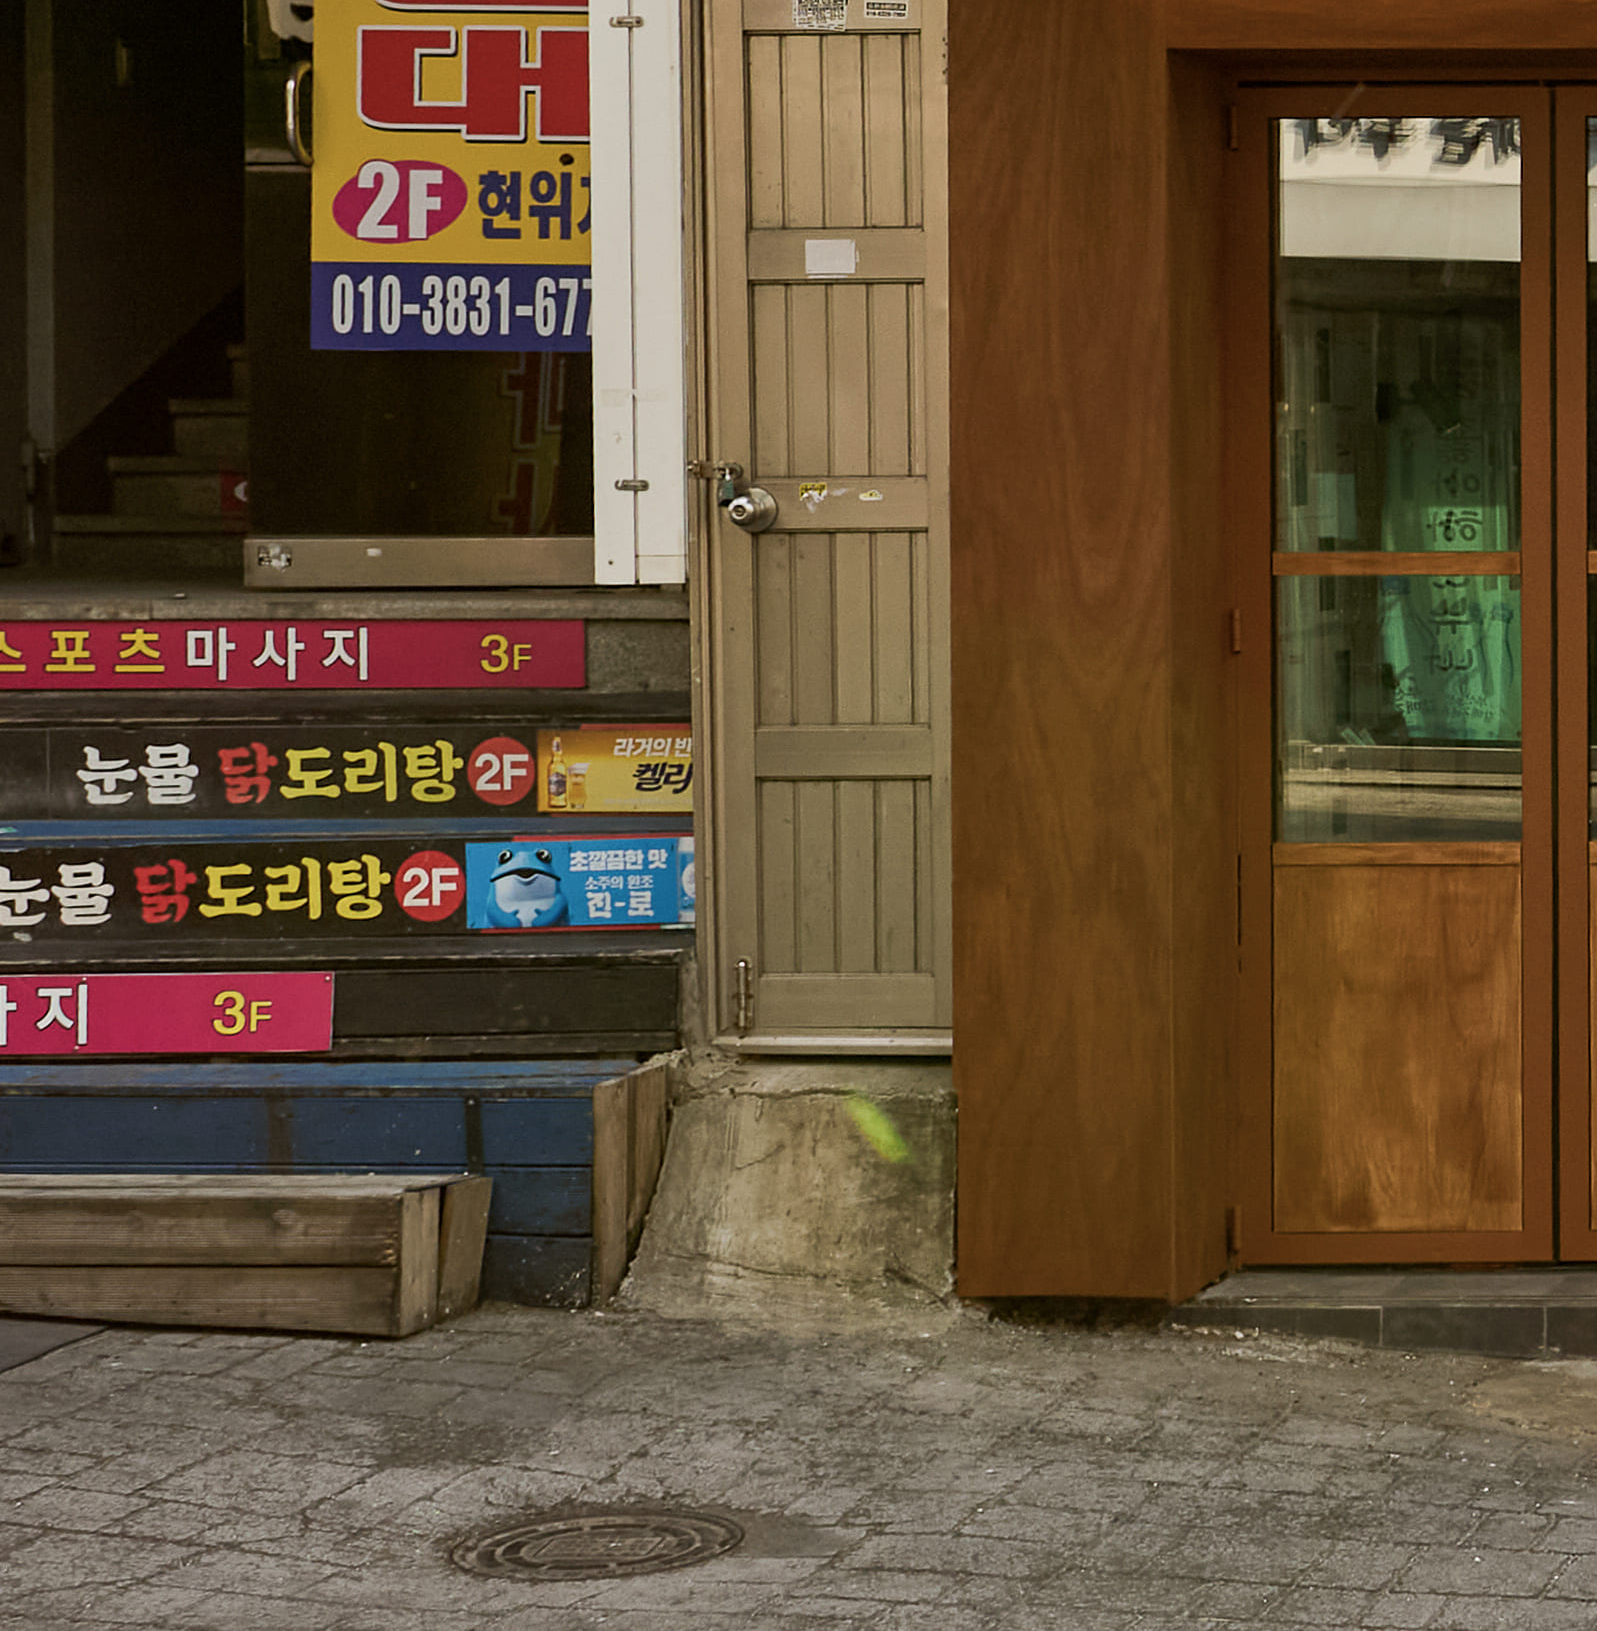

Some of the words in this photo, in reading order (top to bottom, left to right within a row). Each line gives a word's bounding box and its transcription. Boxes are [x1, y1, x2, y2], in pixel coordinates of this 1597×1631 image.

[356, 160, 444, 240] 2F
[185, 625, 370, 681] 마사지
[479, 633, 533, 674] 3F
[75, 741, 200, 806] 눈물
[216, 738, 466, 806] 닭도리탕
[474, 752, 529, 792] 2F
[612, 737, 671, 758] 라거의
[584, 875, 624, 891] 소주의
[627, 874, 654, 890] 원조
[647, 848, 669, 870] 맛
[0, 860, 115, 926] 눈물
[132, 854, 392, 925] 닭도리탕
[401, 866, 461, 909] 2F
[211, 990, 274, 1036] 3F
